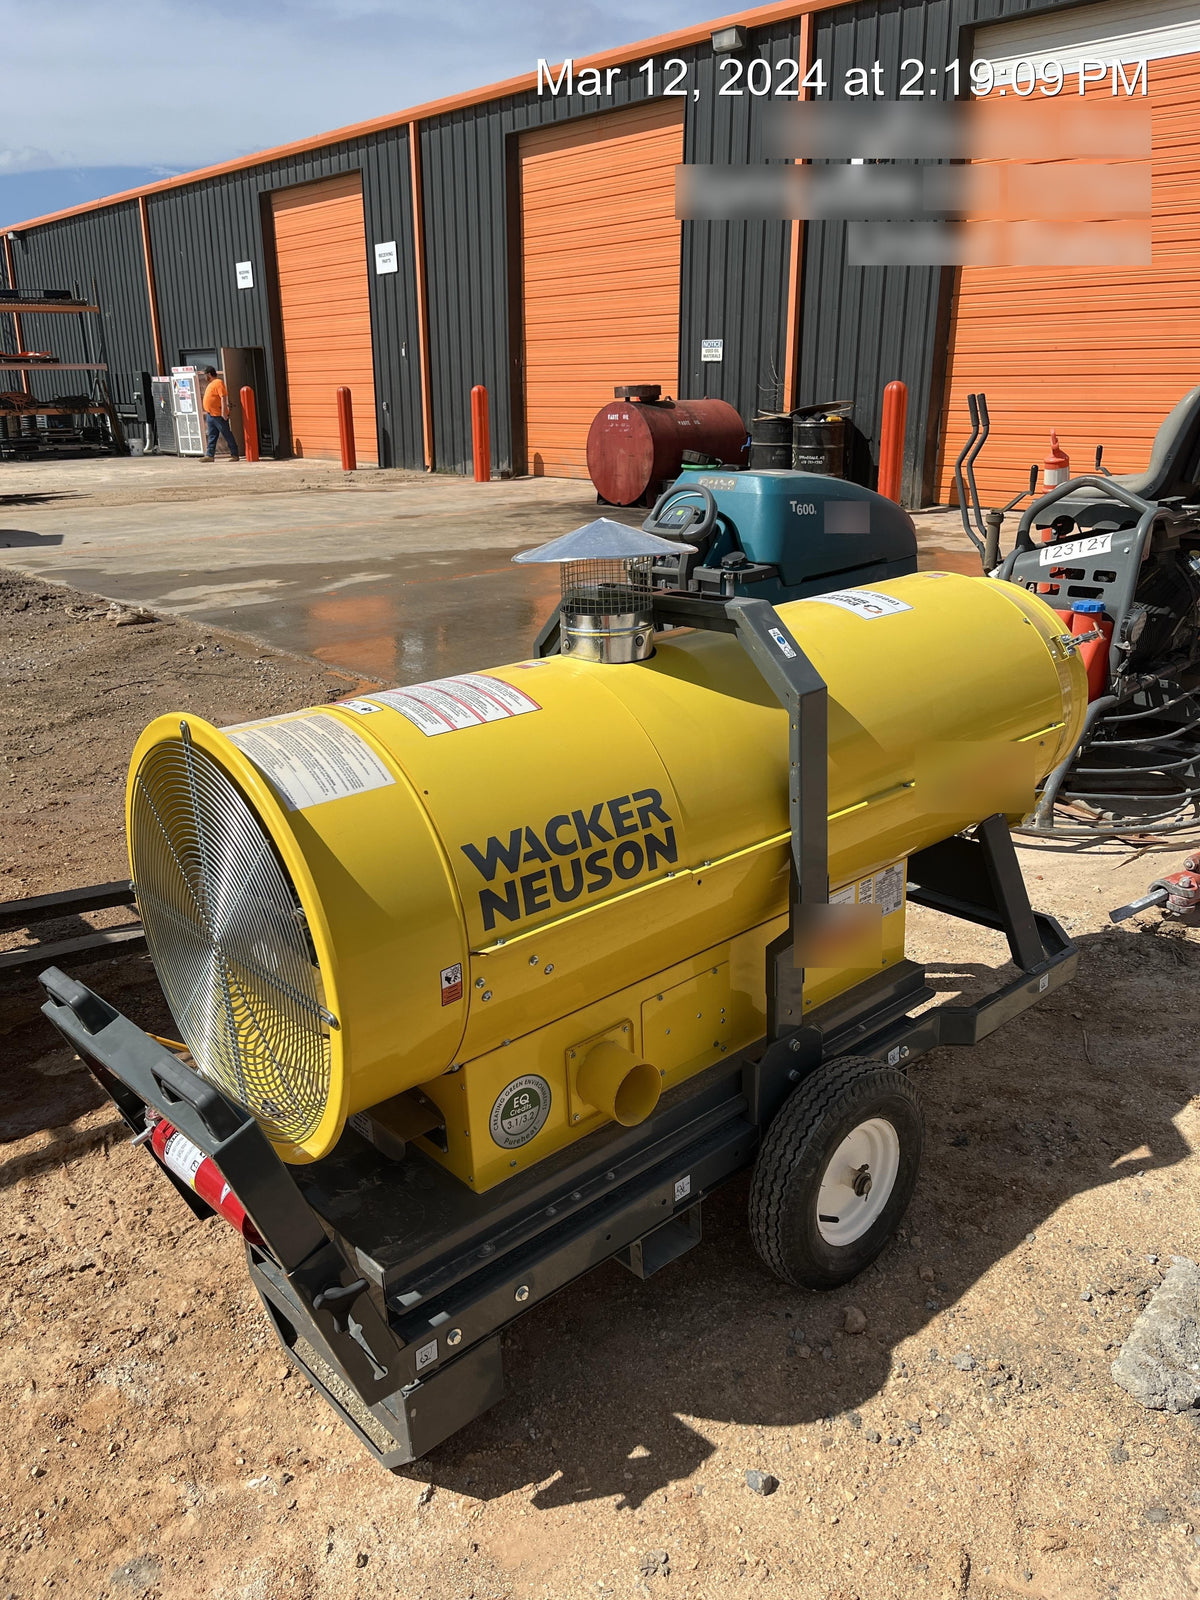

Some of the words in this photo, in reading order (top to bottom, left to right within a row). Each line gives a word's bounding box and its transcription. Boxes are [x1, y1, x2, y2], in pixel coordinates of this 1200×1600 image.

[1043, 534, 1111, 560] 123127
[460, 788, 672, 882] WACKER
[478, 826, 678, 931] NEUSON
[493, 1097, 506, 1131] CREATING
[504, 1080, 524, 1097] GREEN
[524, 1079, 548, 1110] ENVIRONMENTS
[509, 1103, 532, 1117] Credits
[513, 1093, 530, 1109] EQ
[506, 1111, 535, 1130] 3.1/3.2
[503, 1126, 538, 1145] Pureheat
